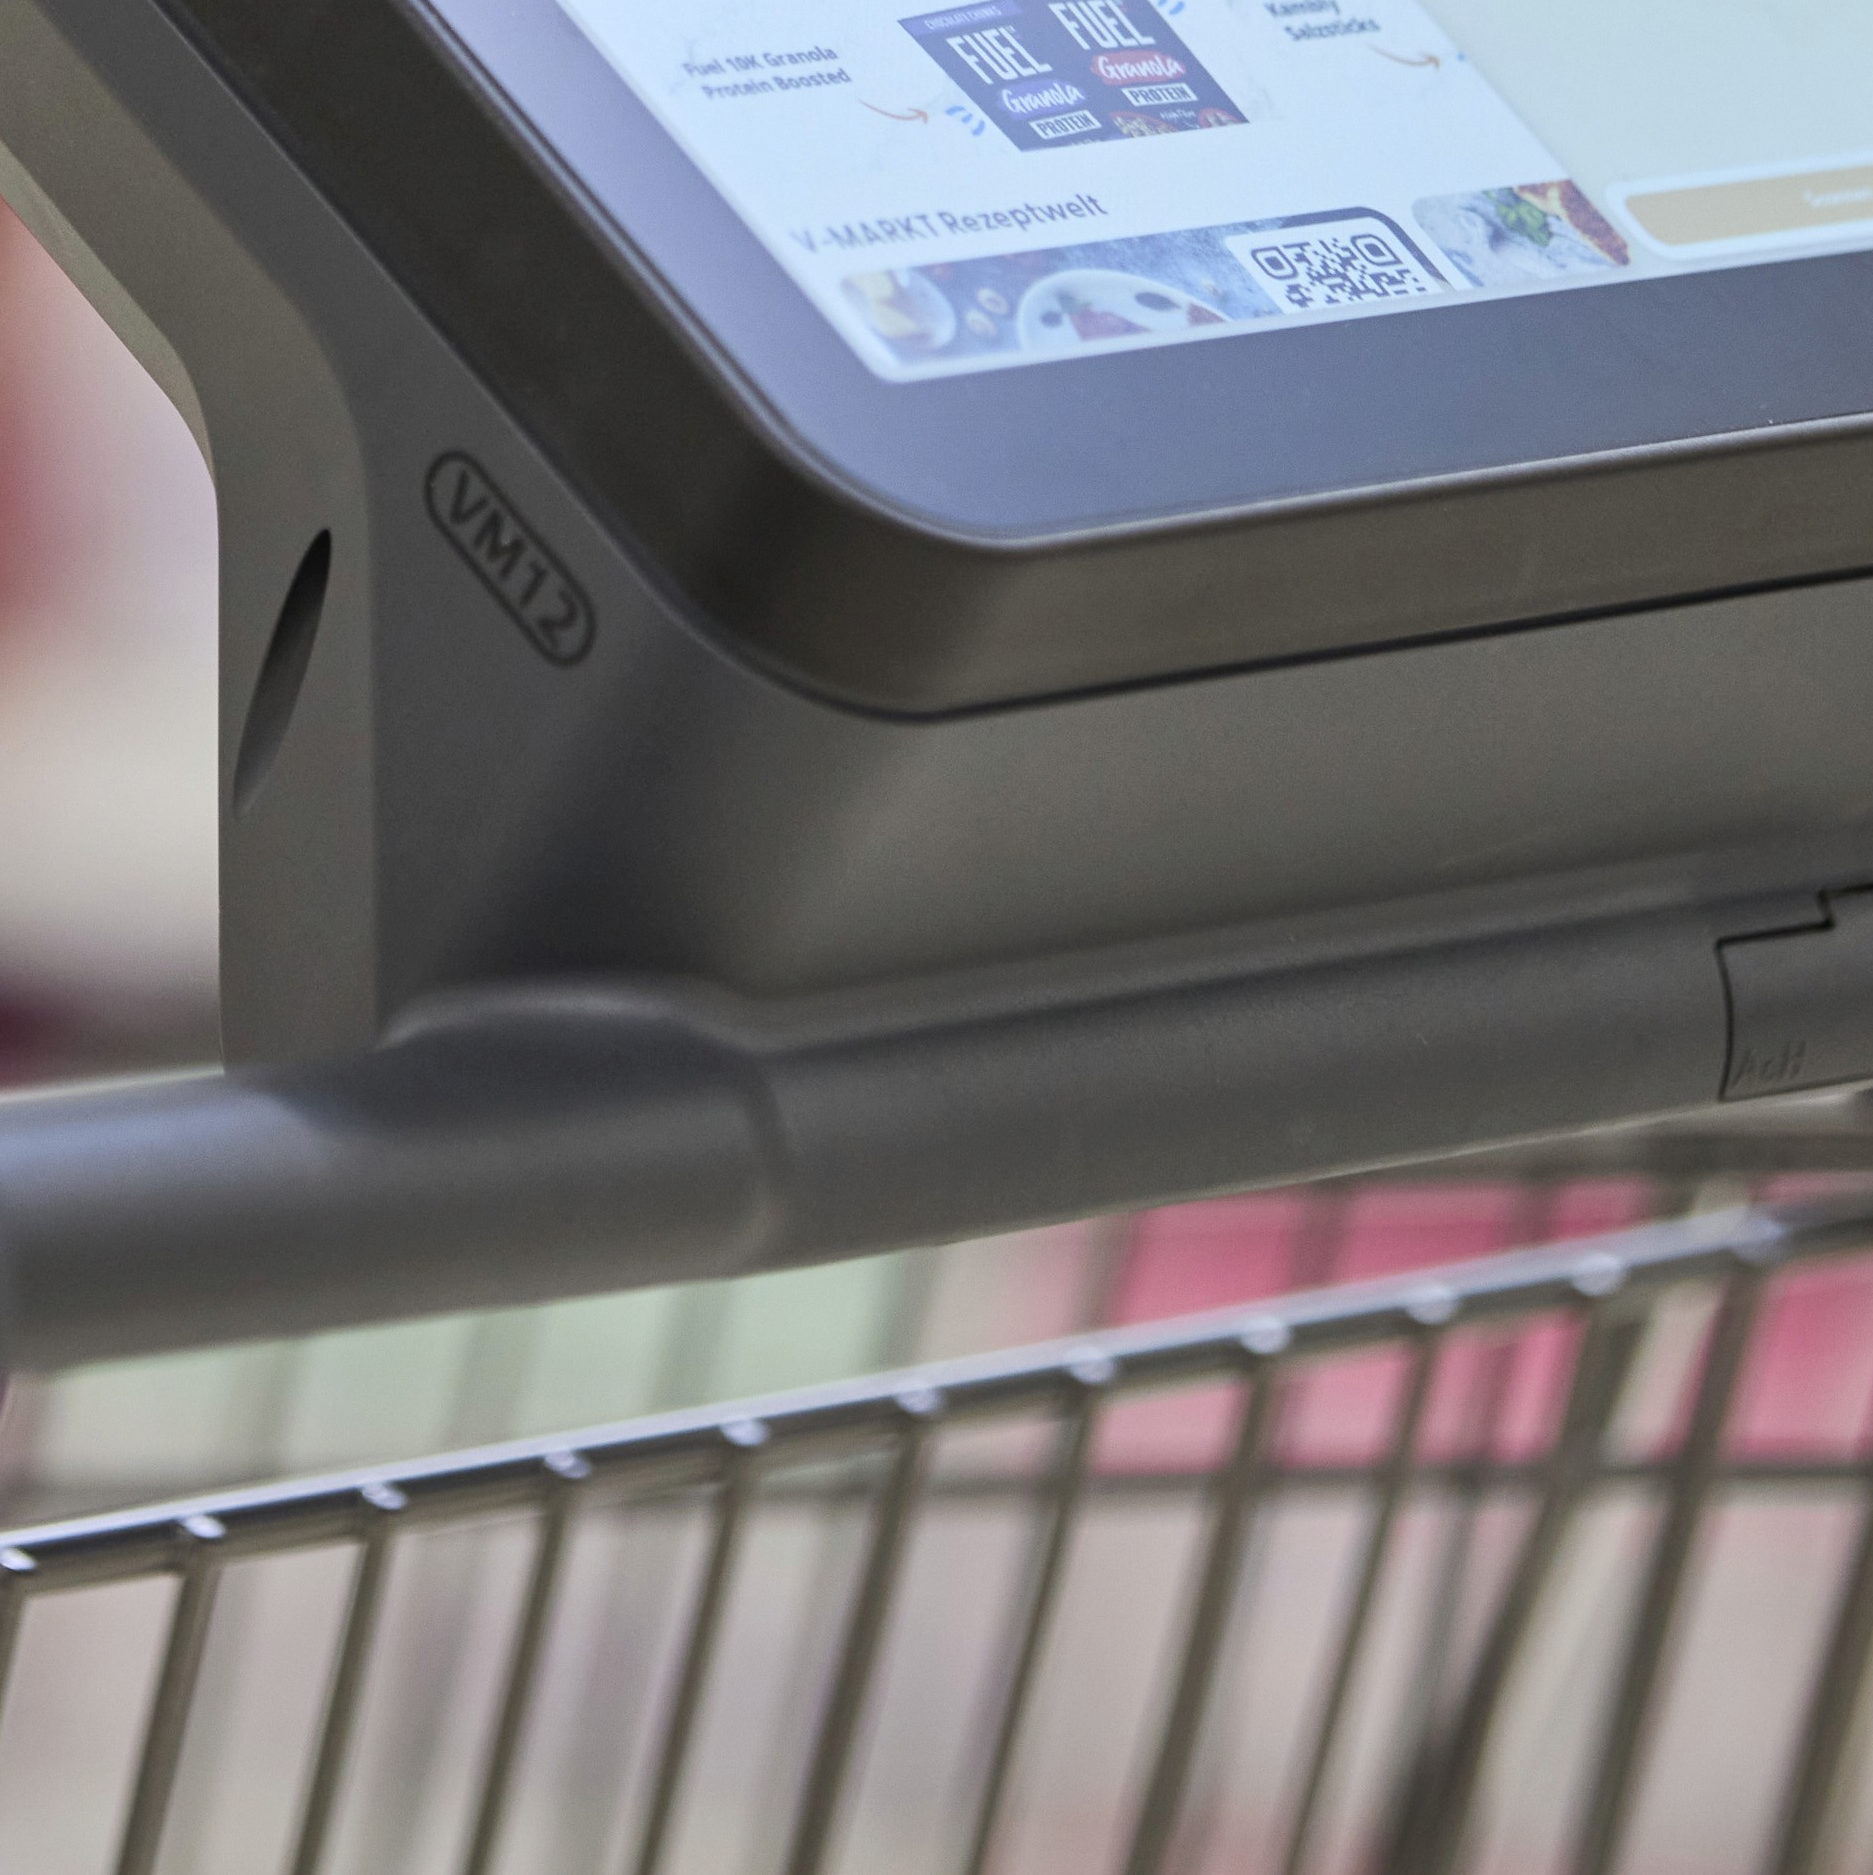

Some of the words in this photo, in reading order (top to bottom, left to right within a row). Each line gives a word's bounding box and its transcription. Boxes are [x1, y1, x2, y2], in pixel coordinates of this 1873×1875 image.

[682, 58, 724, 77] Fuel
[726, 54, 765, 73] 10K
[763, 45, 838, 68] Granola
[946, 25, 1053, 84] FUEL
[1096, 54, 1186, 81] Granola
[700, 76, 775, 99] Protein
[775, 68, 853, 91] Boosted
[1000, 82, 1085, 115] Granola
[1130, 86, 1190, 106] PROTEIN
[1037, 112, 1093, 136] PROTEIN
[789, 213, 940, 253] V-MARKT
[938, 192, 1109, 235] Rezeptwelt
[448, 470, 578, 650] VM12
